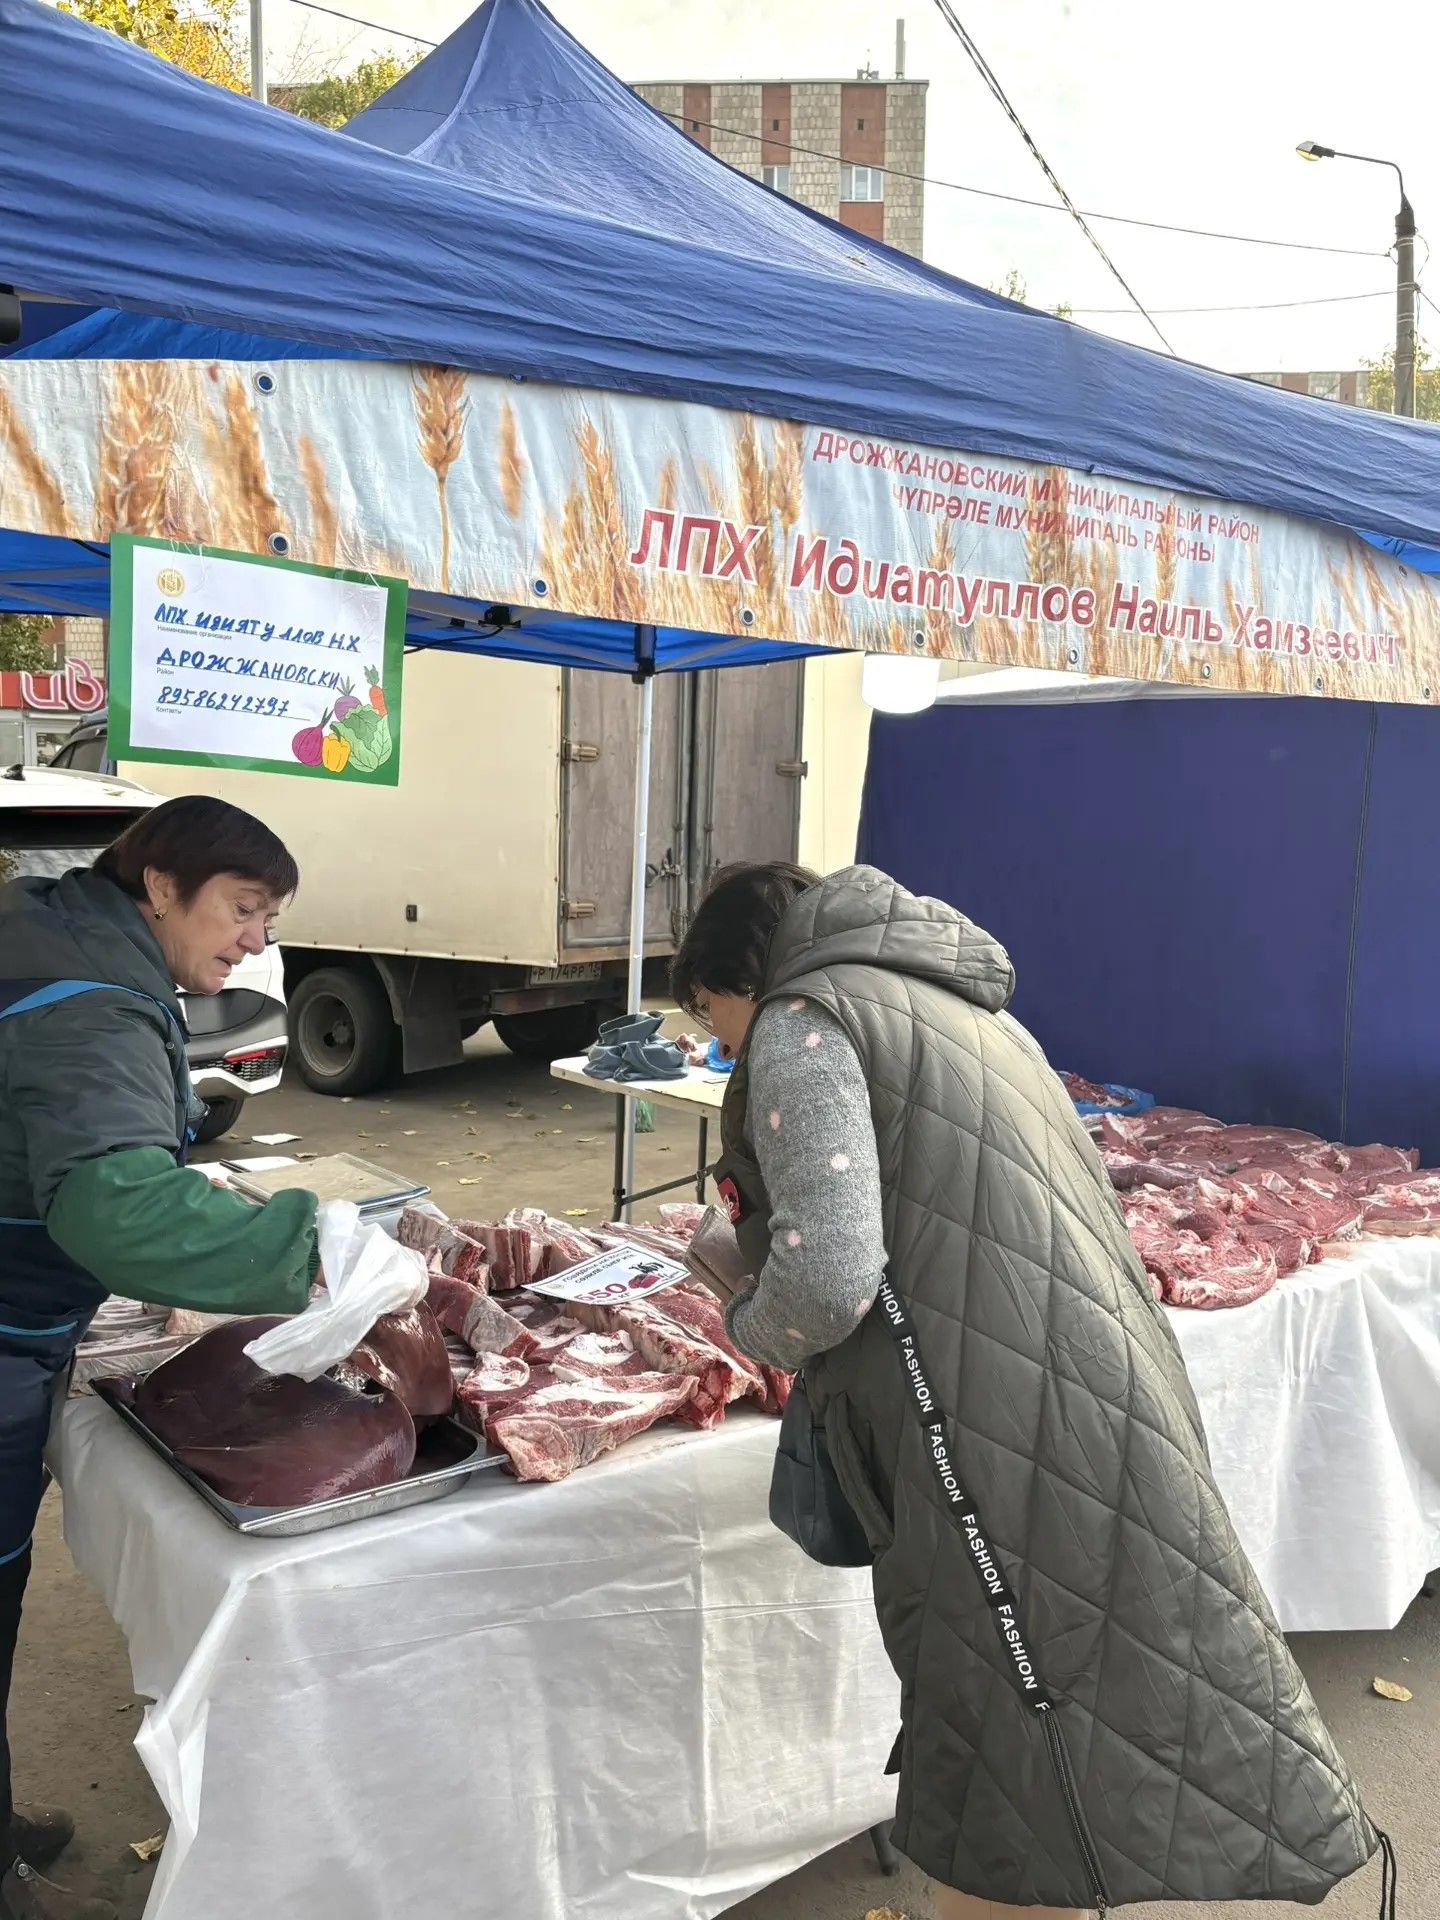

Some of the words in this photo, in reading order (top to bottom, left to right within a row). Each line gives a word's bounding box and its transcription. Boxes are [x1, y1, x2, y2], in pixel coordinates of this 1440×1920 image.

[812, 432, 1027, 497] ДРОЖЖАНОВСКИЙ
[1032, 479, 1202, 532] МУНИЦИПАЛЬНЫЙ
[1209, 514, 1259, 544] РАЙОН
[632, 508, 761, 582] ЛПХ
[790, 534, 1096, 627] Идиатуллов
[1108, 582, 1223, 642] Наиль
[901, 1336, 934, 1413] FASHION
[929, 1424, 964, 1503] FASHION
[962, 1514, 1004, 1595] FASHION
[998, 1604, 1038, 1690] FASHION
